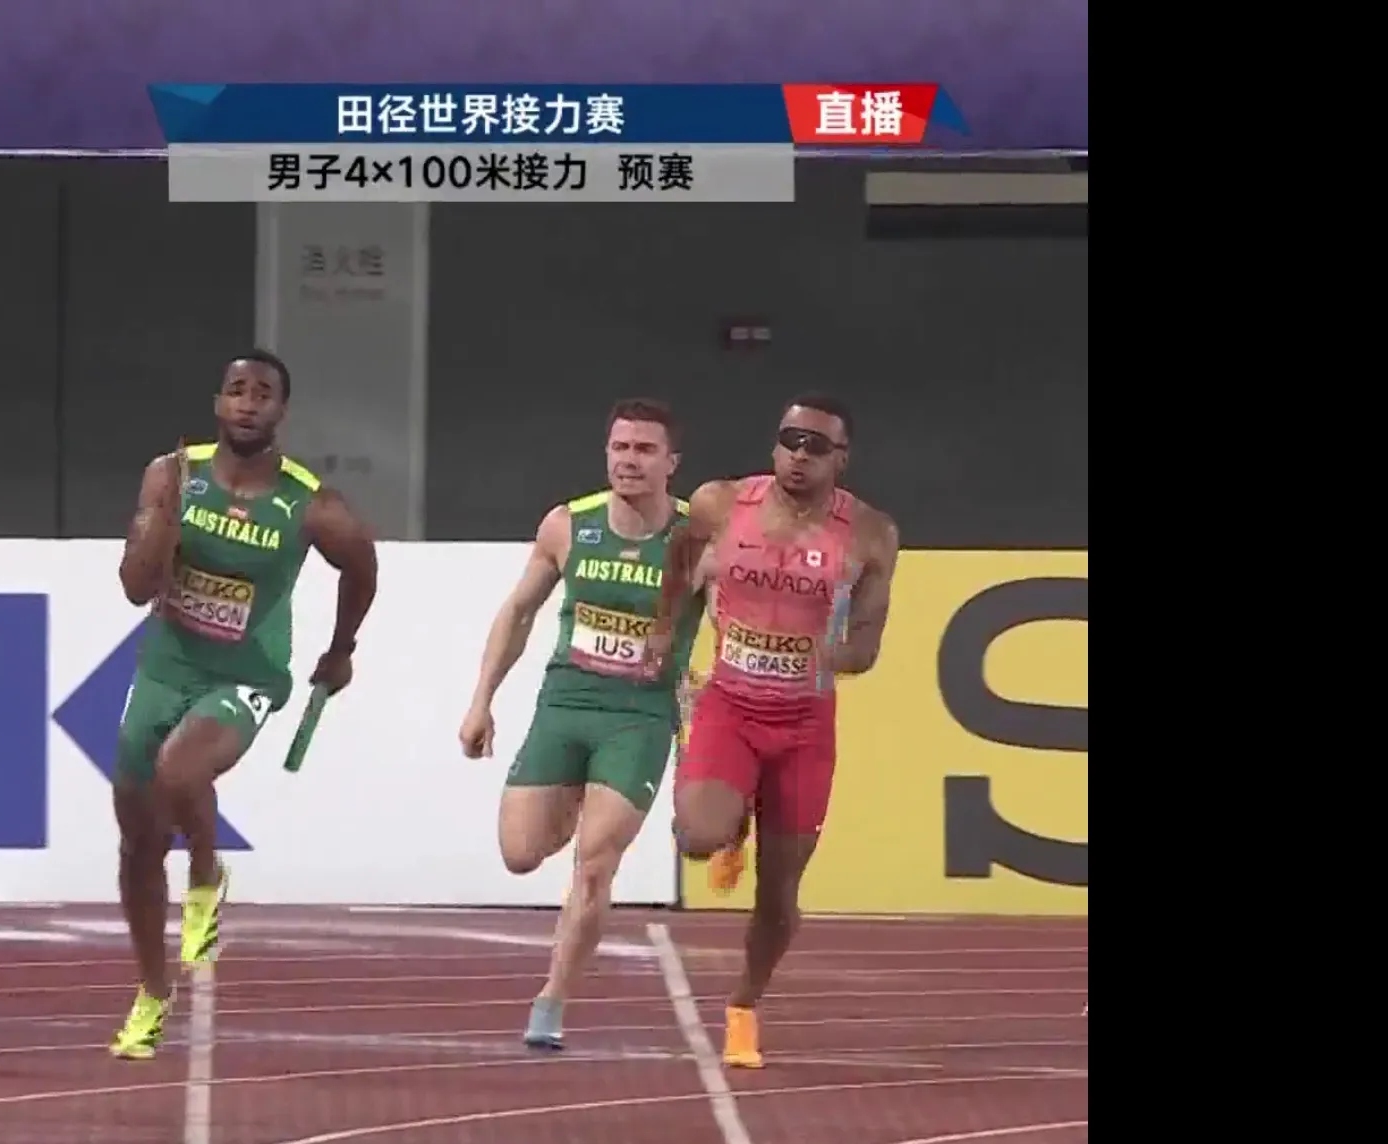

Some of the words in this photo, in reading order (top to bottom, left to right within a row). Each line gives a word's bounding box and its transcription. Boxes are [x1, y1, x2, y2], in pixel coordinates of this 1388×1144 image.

[181, 505, 281, 550] AUSTRALIA
[575, 559, 663, 588] AUSTRALI
[729, 564, 829, 600] CANADA
[594, 635, 635, 659] IUS
[727, 622, 814, 653] SEIKO
[746, 652, 809, 675] GRASSE
